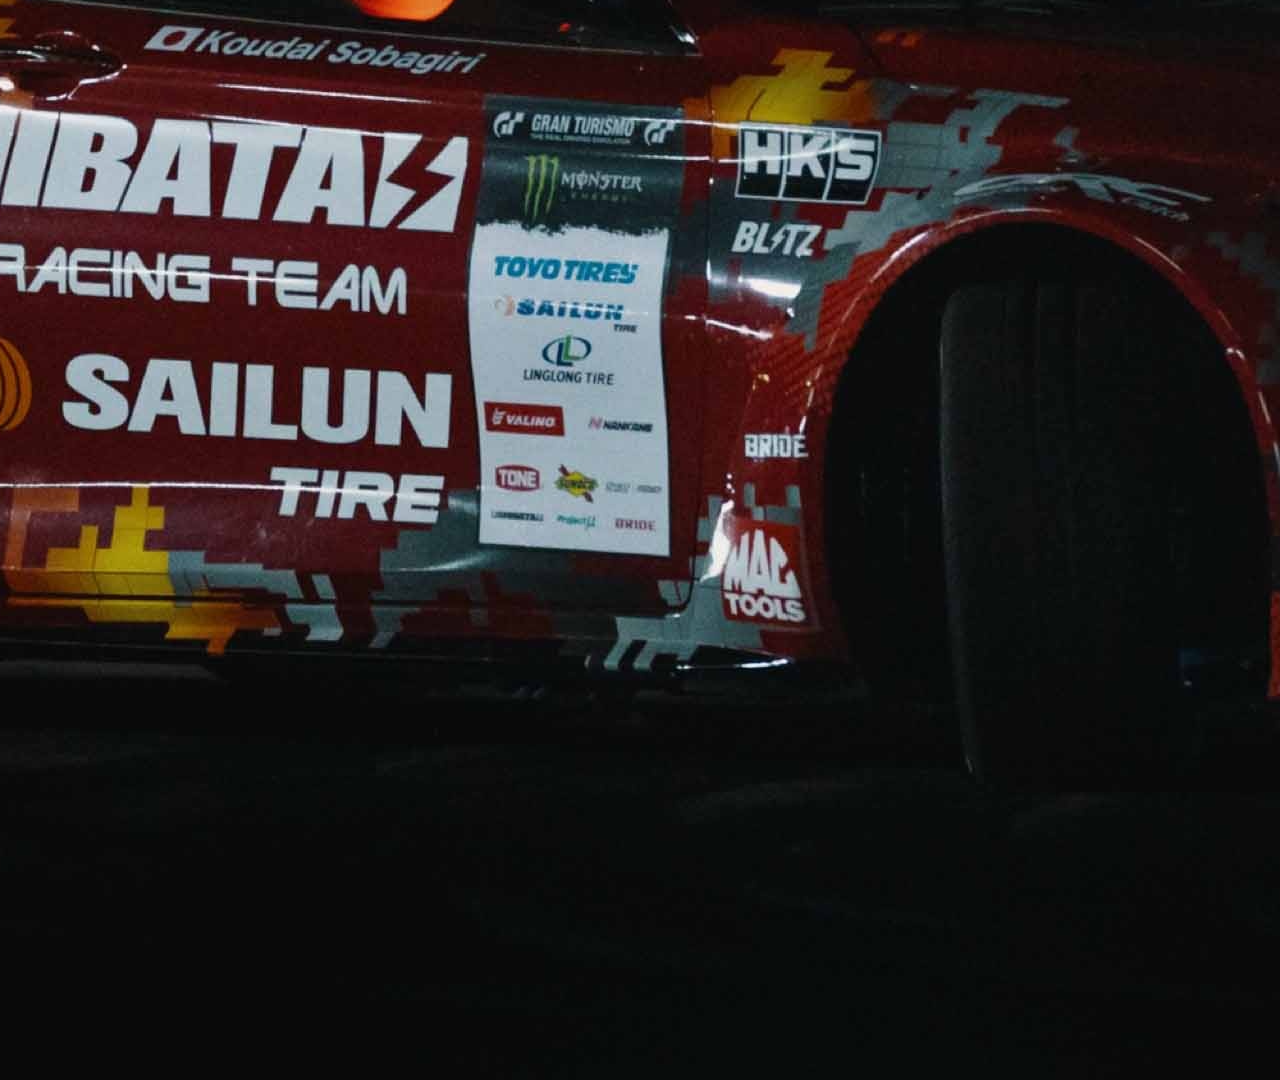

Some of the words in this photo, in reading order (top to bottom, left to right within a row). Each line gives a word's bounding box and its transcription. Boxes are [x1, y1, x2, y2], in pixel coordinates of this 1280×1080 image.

[195, 30, 327, 61] Koudai
[327, 39, 486, 75] Sobagiri
[531, 113, 569, 133] GRAN
[574, 114, 636, 137] TURISMO
[743, 129, 876, 181] HKS
[561, 169, 643, 193] MONSTER
[494, 256, 562, 280] TOYO
[564, 260, 639, 284] TIRES
[230, 257, 409, 316] TEAM
[516, 298, 625, 321] SAILUN
[613, 323, 638, 334] TIRE
[523, 369, 582, 384] LINGLONG
[585, 372, 615, 386] TIRE
[62, 353, 452, 449] SAILUN
[506, 414, 556, 428] VALINO
[744, 433, 809, 458] BRIDE
[497, 469, 538, 489] TONE
[269, 467, 445, 524] TIRE
[723, 528, 801, 599] MAC
[725, 592, 806, 623] TOOLS
